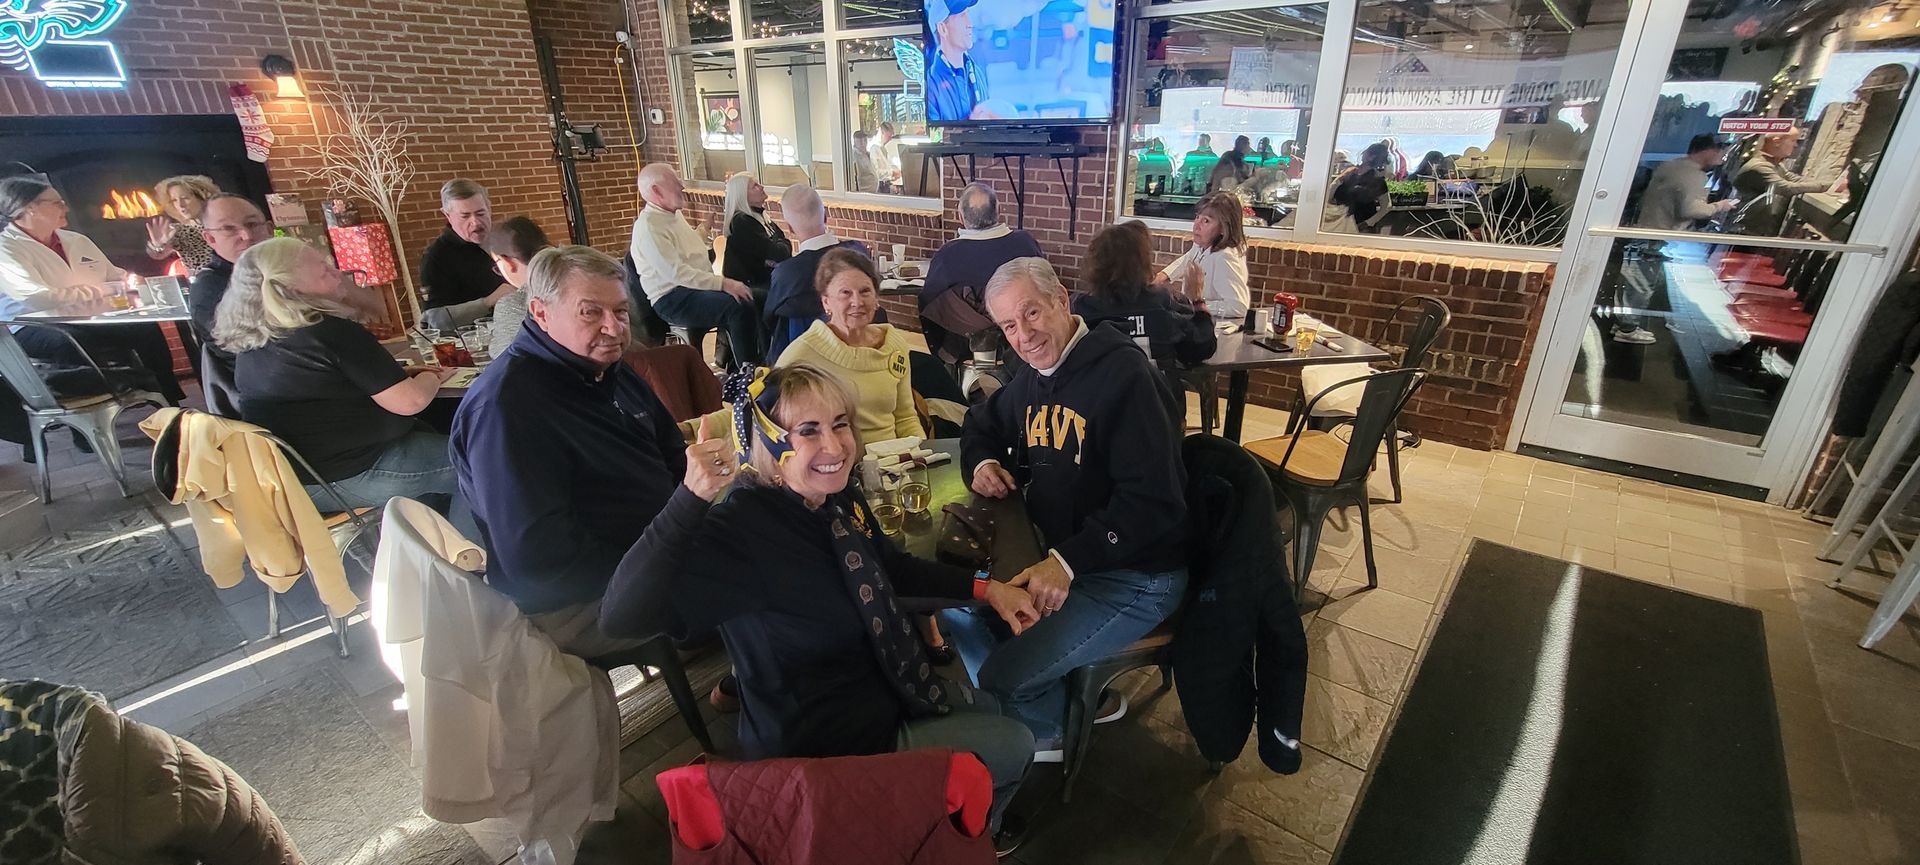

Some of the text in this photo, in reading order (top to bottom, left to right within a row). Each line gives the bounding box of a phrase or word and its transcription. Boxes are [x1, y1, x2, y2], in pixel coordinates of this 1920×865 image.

[1749, 122, 1768, 130] YOUR
[1770, 122, 1792, 130] STEP
[897, 354, 905, 365] GO
[892, 362, 907, 375] NAVY
